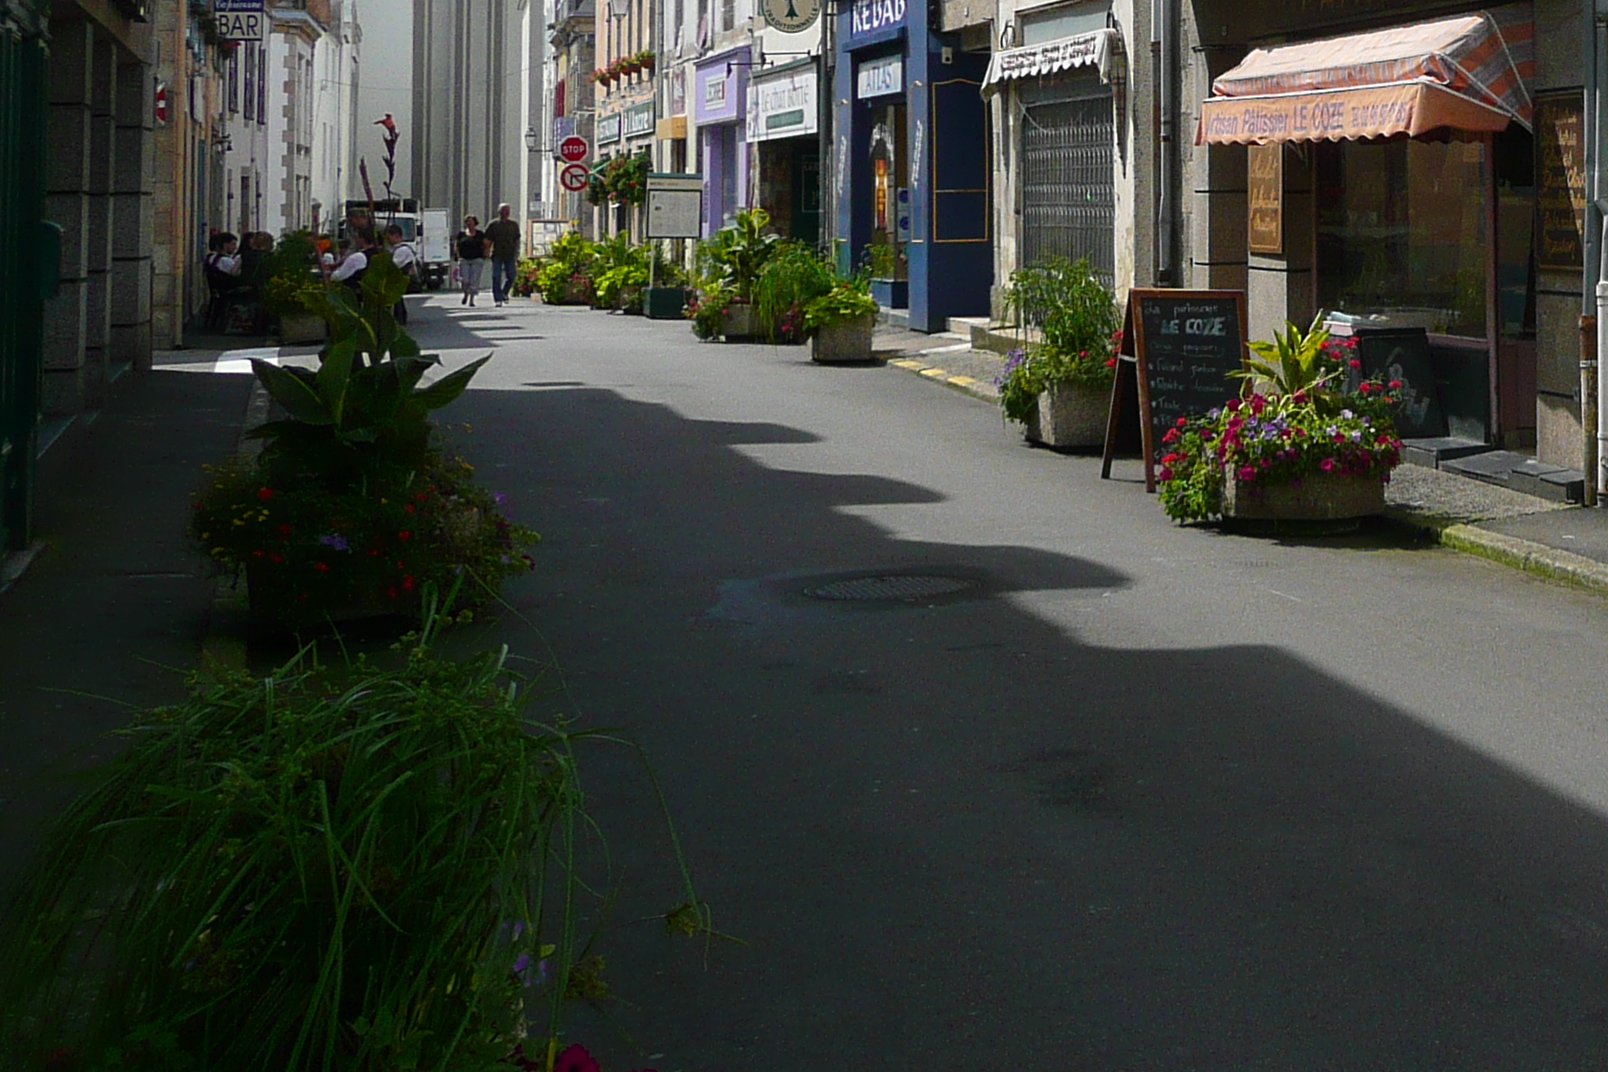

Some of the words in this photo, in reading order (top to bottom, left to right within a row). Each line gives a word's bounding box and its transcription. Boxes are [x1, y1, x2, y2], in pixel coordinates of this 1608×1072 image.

[218, 14, 258, 36] BAR
[1206, 111, 1239, 135] Artisan
[1293, 105, 1308, 131] LE
[1312, 101, 1346, 130] COZE
[562, 144, 585, 155] STOP
[1185, 317, 1226, 336] COZE
